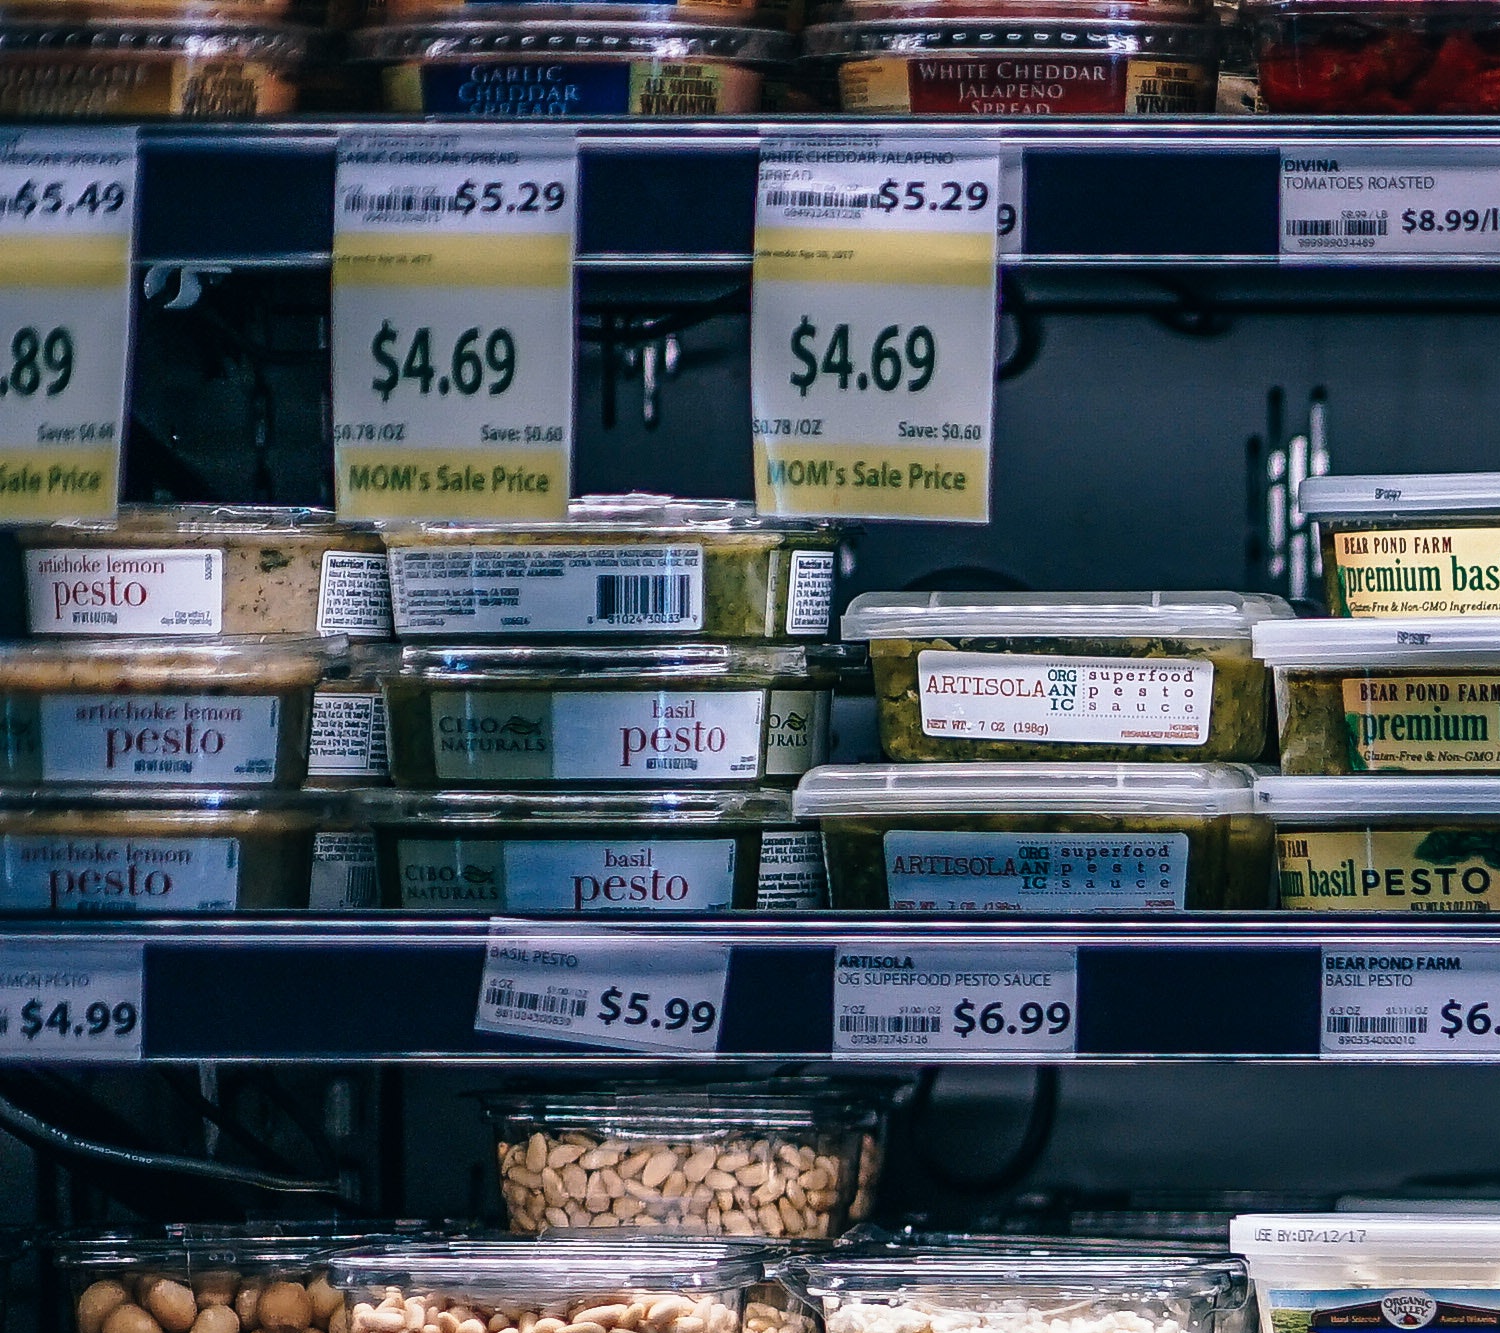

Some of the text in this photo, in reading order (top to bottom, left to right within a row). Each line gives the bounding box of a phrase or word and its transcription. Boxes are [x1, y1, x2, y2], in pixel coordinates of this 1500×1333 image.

[918, 61, 1106, 81] WHITE CHEDDAR
[959, 82, 1064, 103] JALAPEÑO
[1282, 156, 1342, 173] DIVINA
[1283, 175, 1435, 190] TOMATOES ROASTED
[454, 181, 565, 214] $5.29
[371, 319, 516, 404] $4.69
[349, 463, 550, 494] MOM's Sale Price
[1343, 536, 1453, 555] BEAR POND FARM
[38, 555, 165, 574] artichoke lemon
[1343, 555, 1442, 597] premium
[50, 575, 147, 617] pesto
[925, 674, 1047, 698] ARTISOLA
[1088, 670, 1195, 685] superfood
[596, 985, 717, 1034] $5.99
[953, 999, 1071, 1039] $6.99
